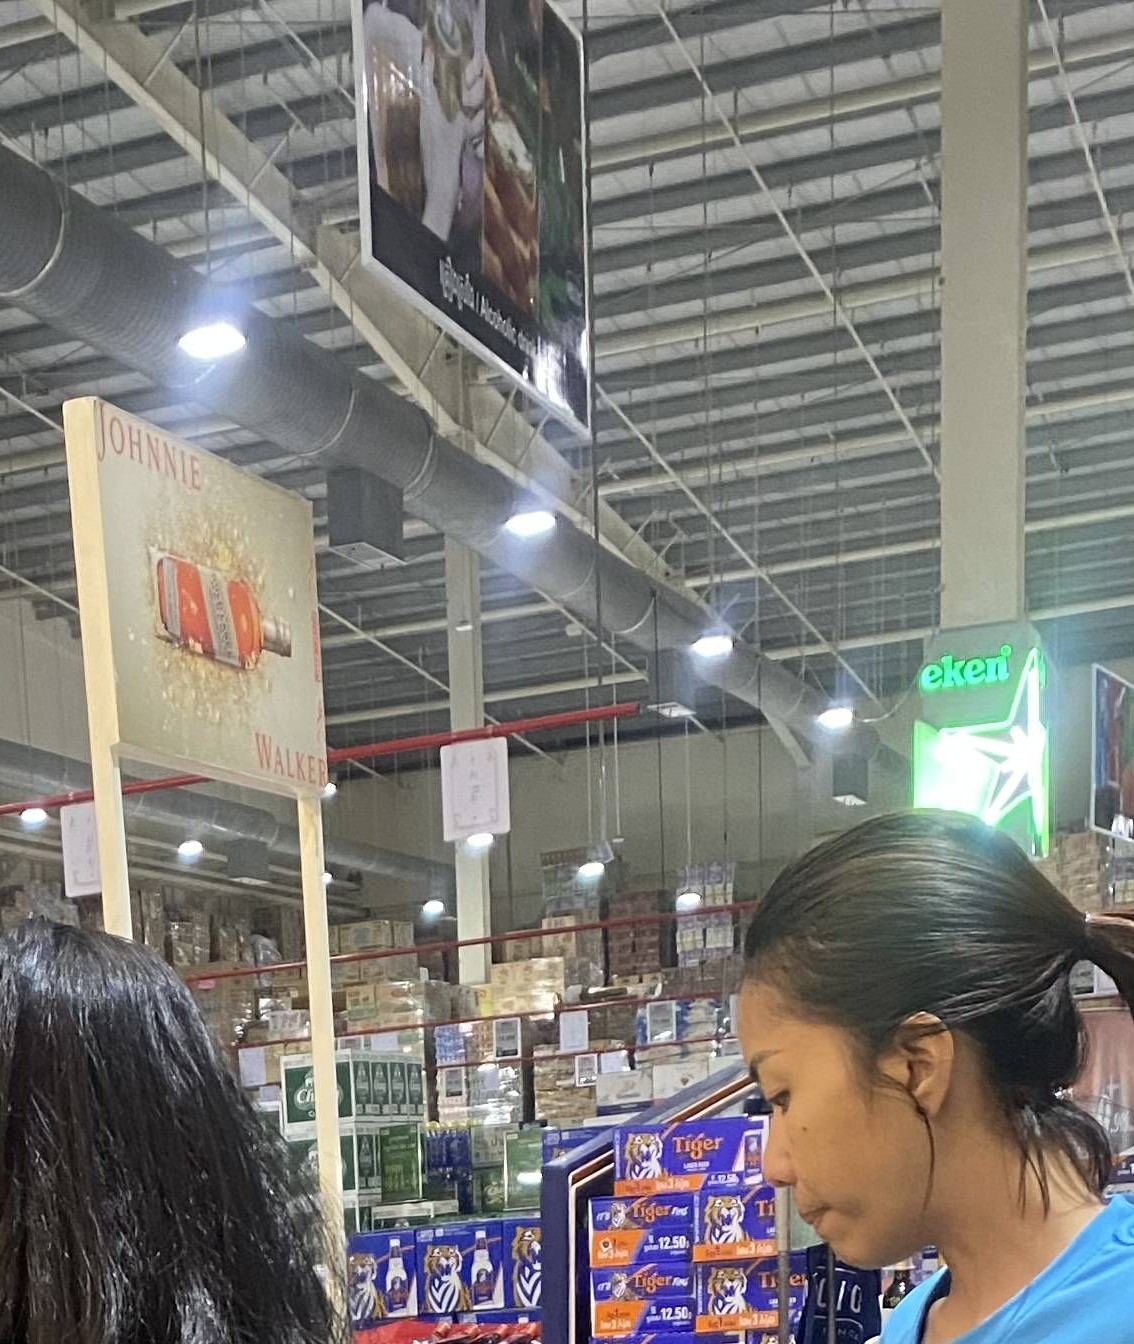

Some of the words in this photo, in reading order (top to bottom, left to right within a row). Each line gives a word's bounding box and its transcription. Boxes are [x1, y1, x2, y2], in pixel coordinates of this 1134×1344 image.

[96, 402, 202, 491] JOHNNIE
[255, 731, 328, 786] WALKER
[672, 1133, 723, 1159] Tiger
[632, 1202, 672, 1223] Tiger
[633, 1271, 672, 1293] Tiger
[758, 1271, 806, 1289] Tier
